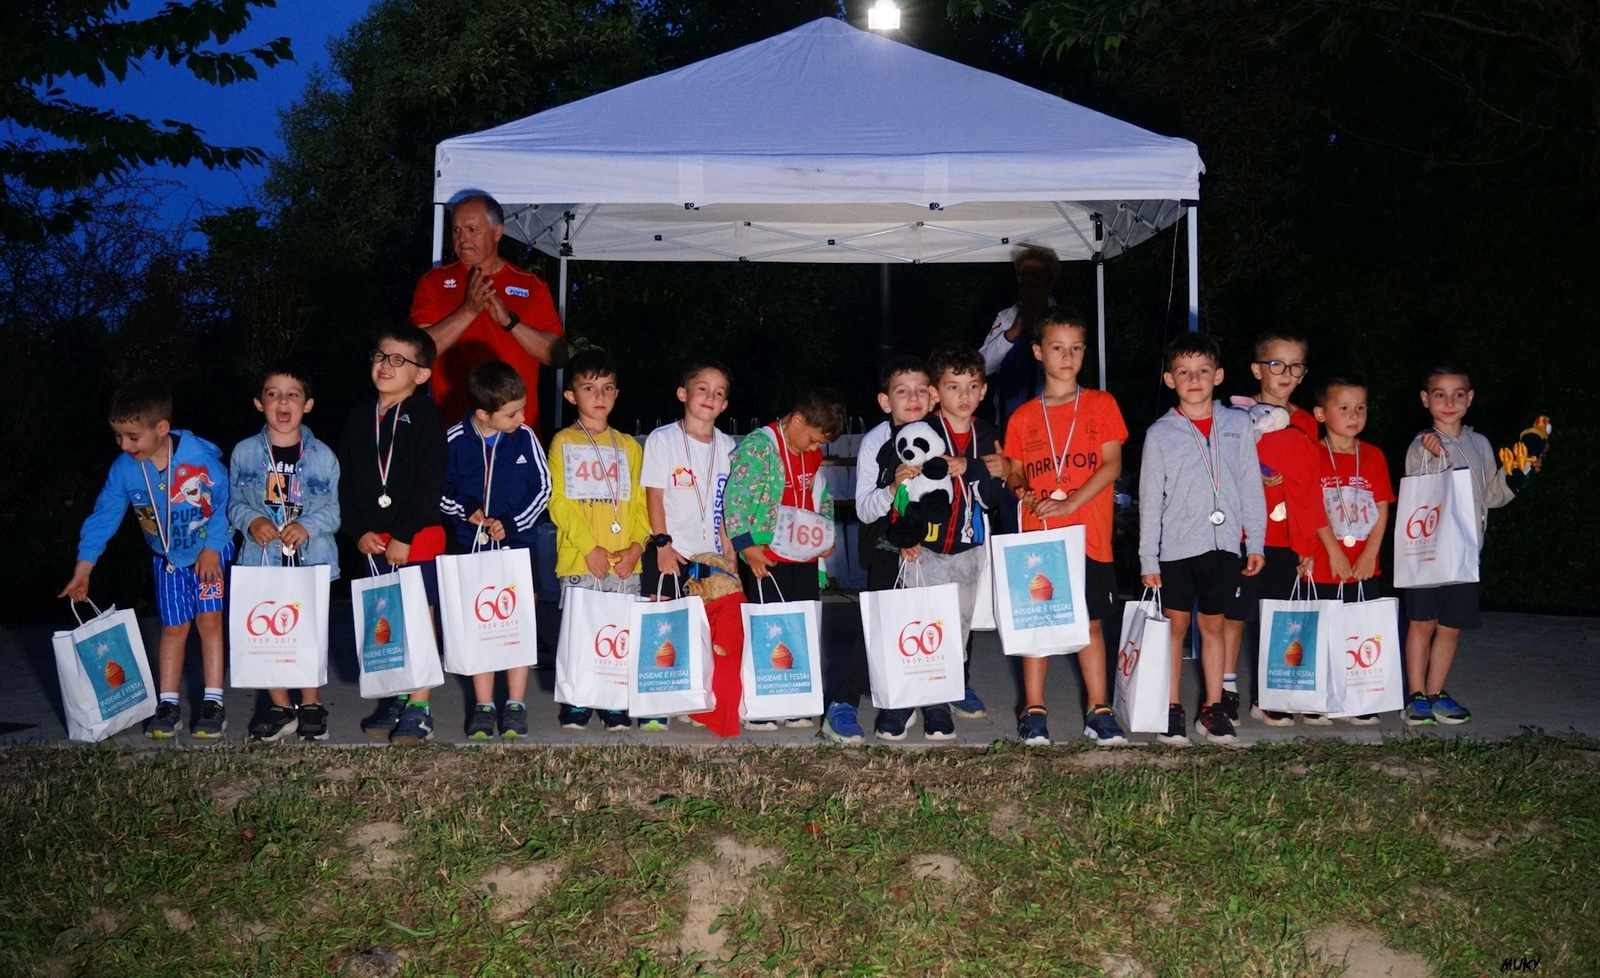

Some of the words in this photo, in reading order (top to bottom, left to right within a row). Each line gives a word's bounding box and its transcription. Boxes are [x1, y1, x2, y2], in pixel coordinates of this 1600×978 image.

[575, 460, 618, 482] 404
[171, 507, 204, 524] PUPS
[1406, 505, 1440, 540] 60
[172, 524, 189, 538] AT
[787, 521, 824, 548] 169
[198, 578, 225, 600] 23
[475, 586, 517, 622] 60
[1013, 606, 1042, 616] INSIEME
[1050, 603, 1072, 611] FESTA!
[246, 600, 300, 636] 60
[478, 619, 519, 630] 1959-2019
[594, 624, 630, 660] 60
[898, 620, 943, 657] 60
[594, 659, 628, 667] 1959-201
[902, 654, 946, 665] 1959-2019
[670, 669, 689, 678] FESTA!
[757, 674, 783, 682] INSIEME
[784, 672, 788, 681] È
[790, 672, 810, 681] FESTA!
